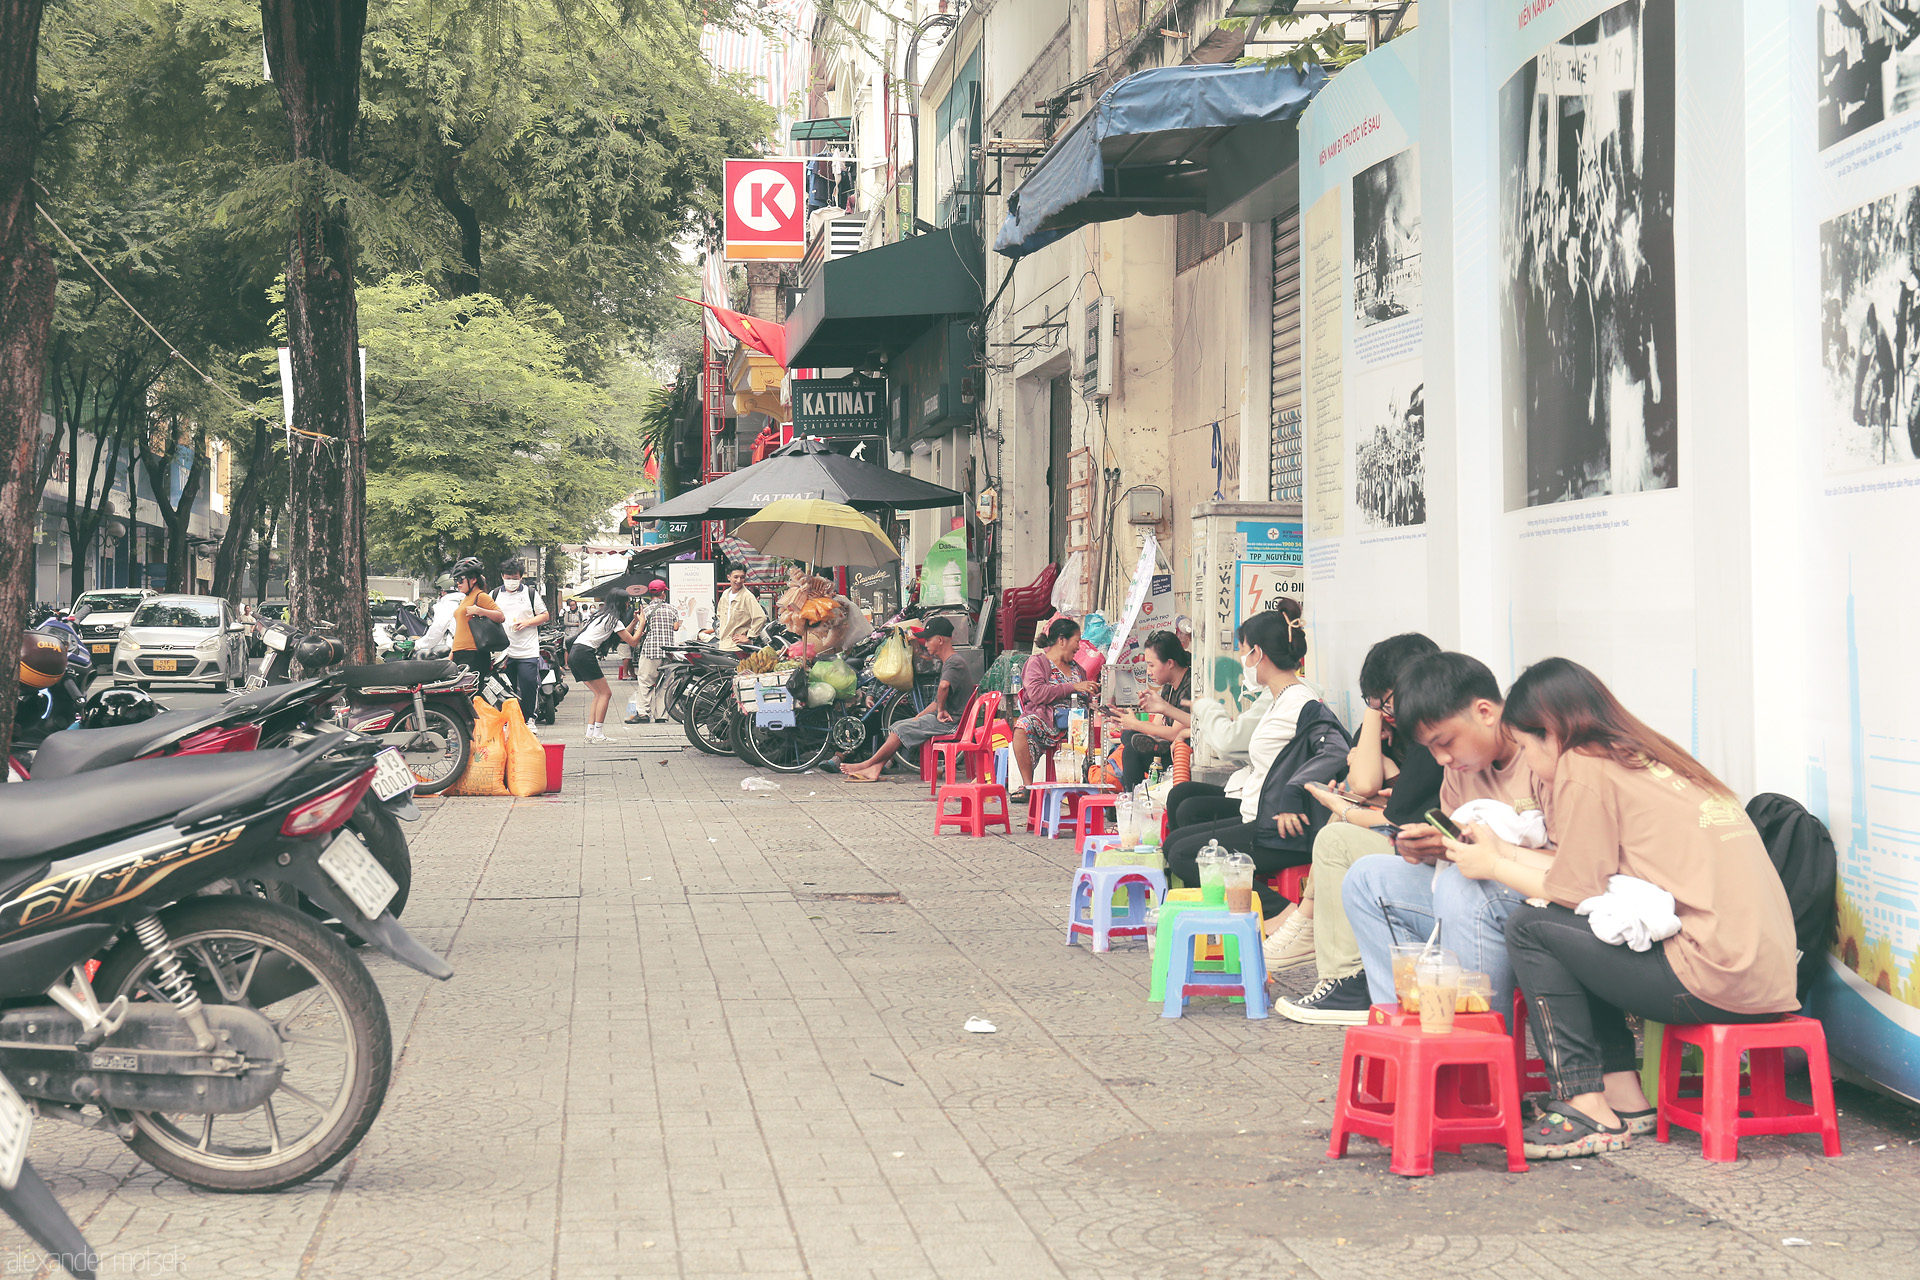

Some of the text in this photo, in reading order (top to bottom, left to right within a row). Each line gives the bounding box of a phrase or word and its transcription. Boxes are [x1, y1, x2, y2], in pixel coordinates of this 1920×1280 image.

[1368, 113, 1381, 133] SAU
[802, 391, 876, 416] KATINAT
[752, 491, 814, 502] KATINAT
[669, 524, 688, 533] 24/7
[1275, 581, 1288, 592] CÓ
[1156, 621, 1172, 629] DỊCH
[374, 767, 413, 798] 200.07
